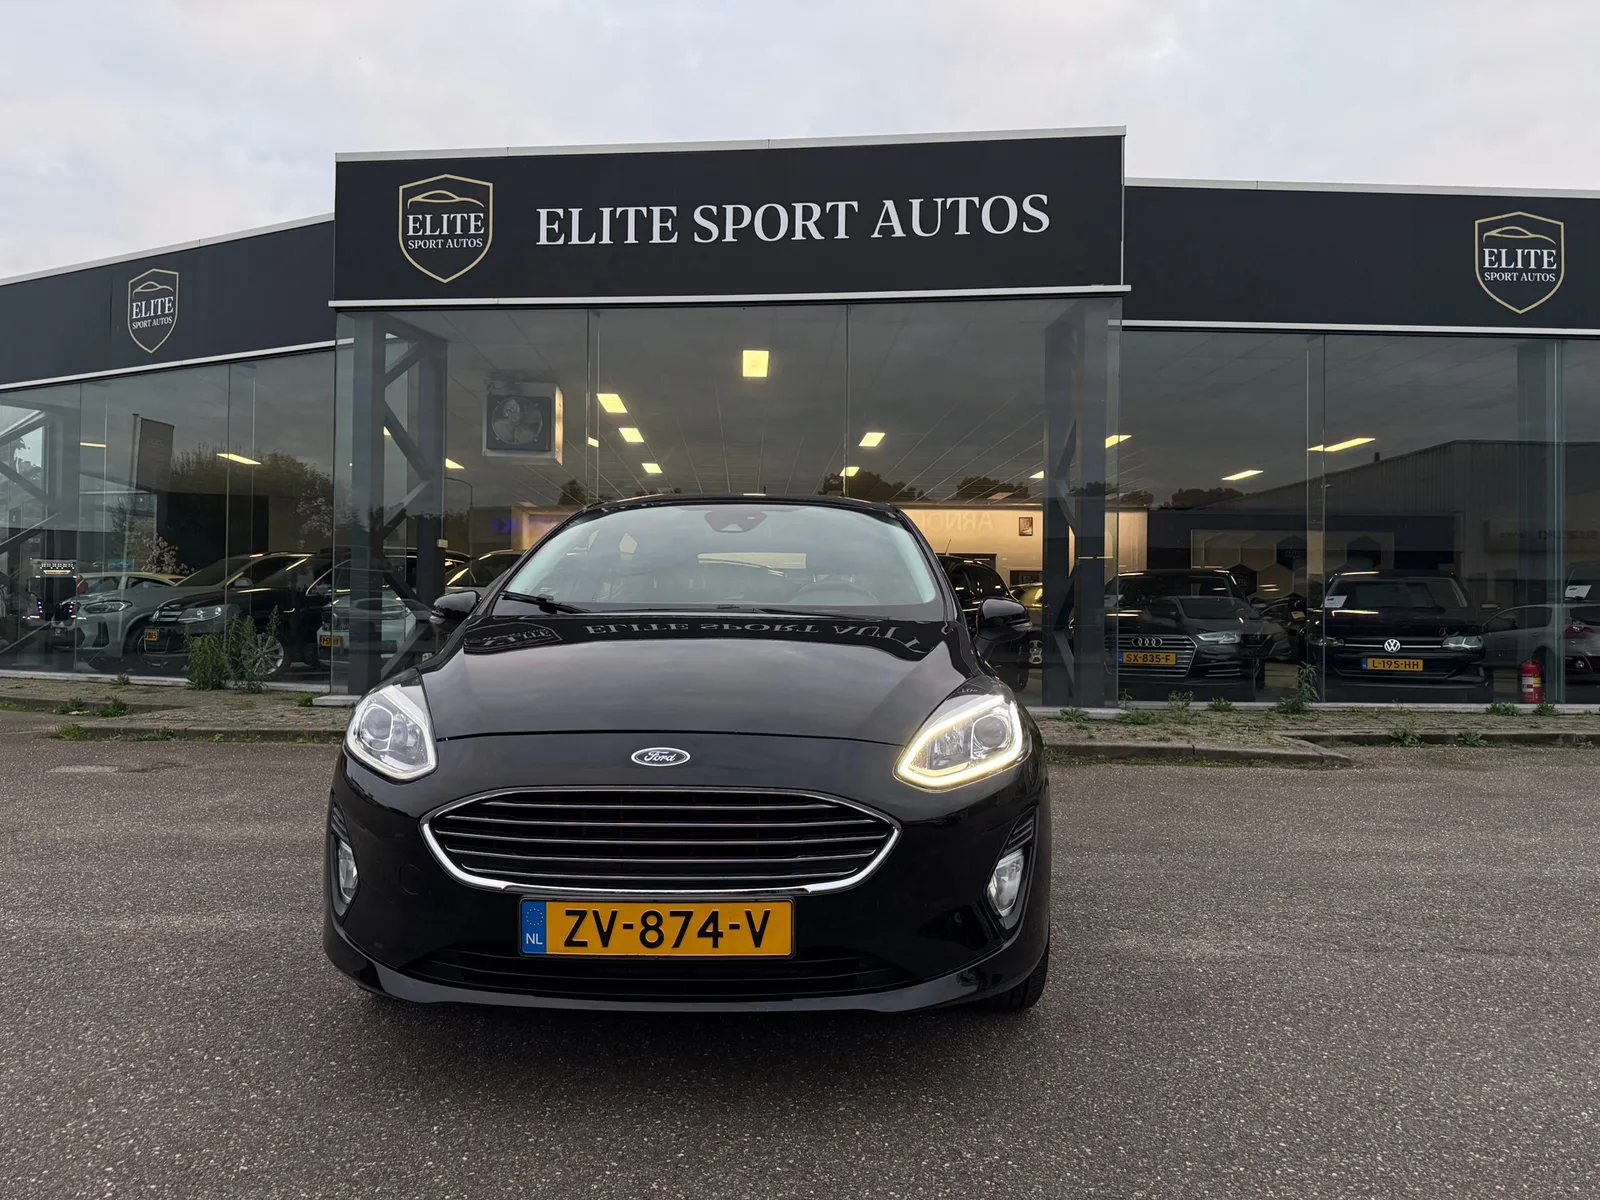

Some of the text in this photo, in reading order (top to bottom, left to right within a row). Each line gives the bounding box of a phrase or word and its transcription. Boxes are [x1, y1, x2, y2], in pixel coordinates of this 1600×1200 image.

[407, 213, 485, 236] ELITE
[536, 194, 1050, 245] ELITE SPORT AUTOS
[408, 238, 483, 250] SPORT AUTOS
[1483, 248, 1557, 269] ELITE
[1484, 272, 1556, 282] SPORT AUTOS
[132, 296, 174, 319] ELITE
[132, 316, 173, 330] SPORT AUTOS
[1126, 653, 1171, 663] SX-835-F
[1372, 660, 1419, 669] L-195-HH
[526, 909, 771, 949] NL ZV-874-V
